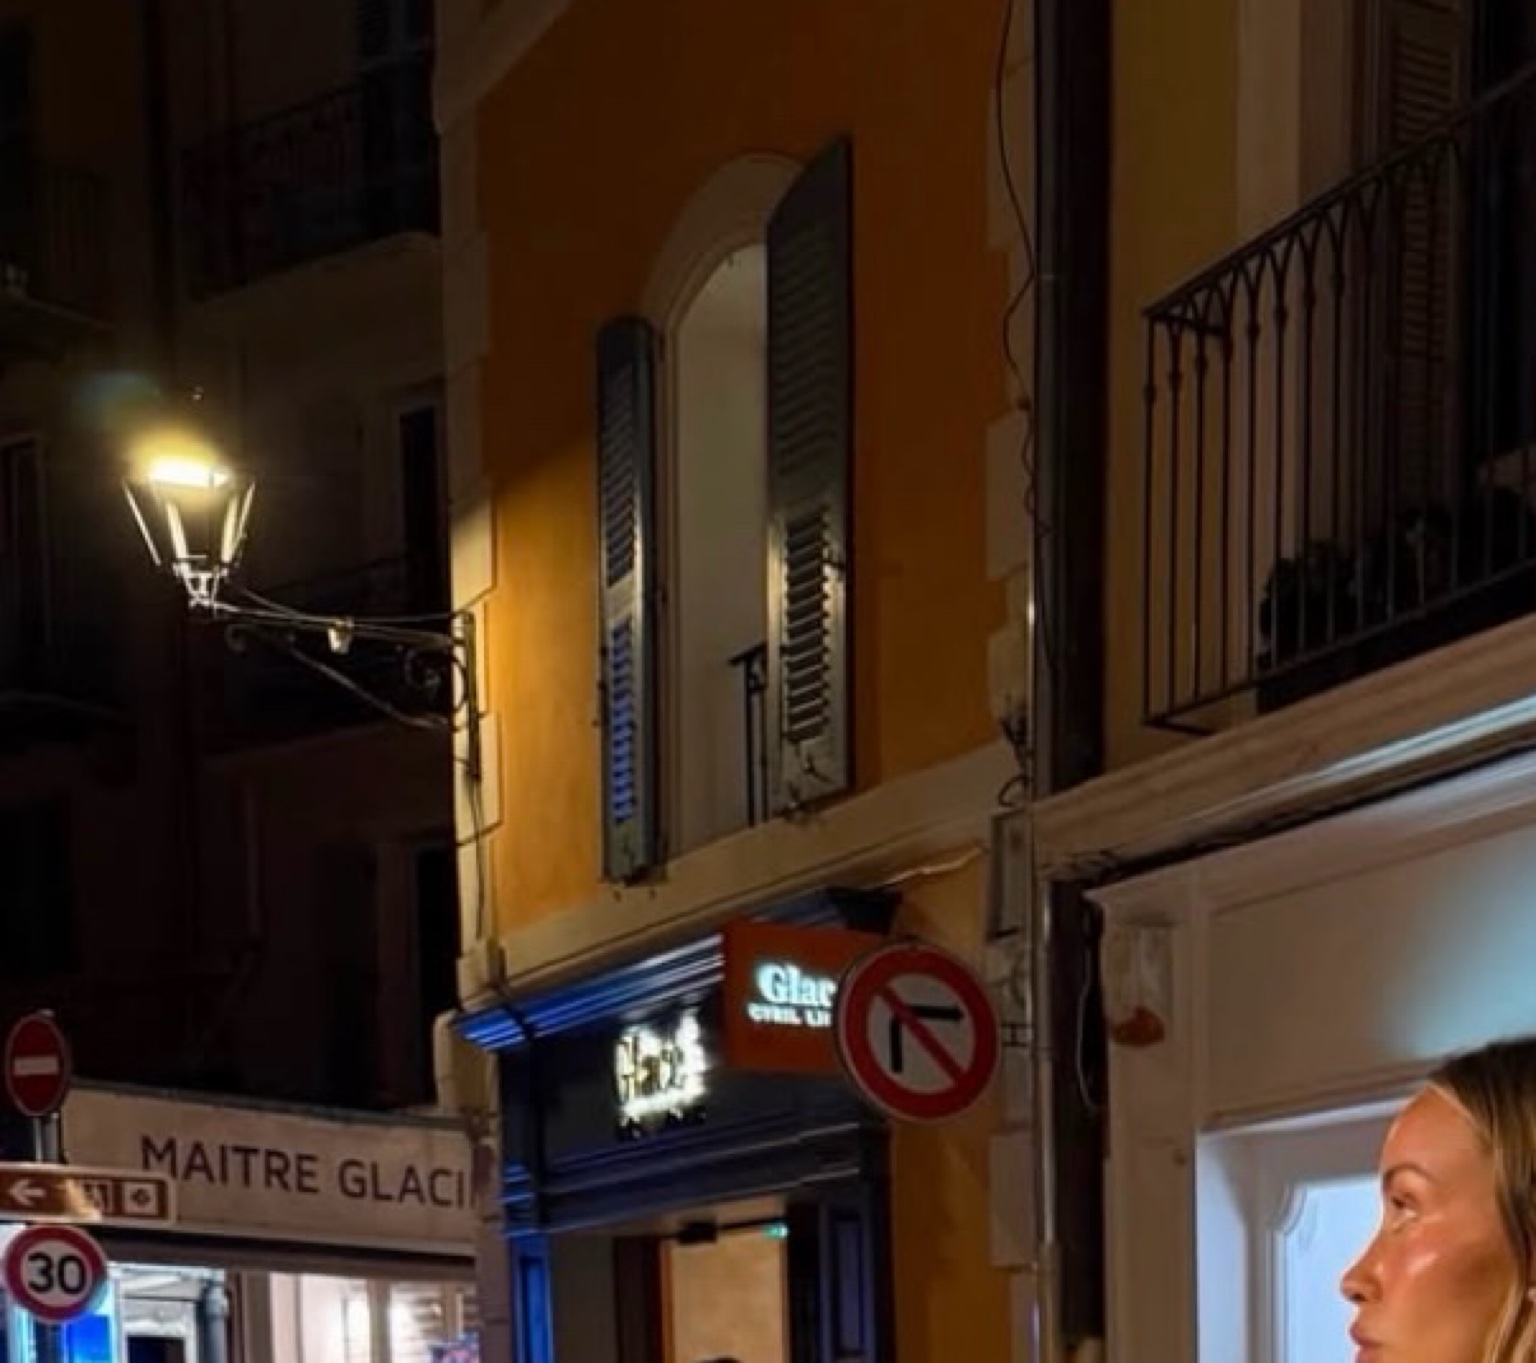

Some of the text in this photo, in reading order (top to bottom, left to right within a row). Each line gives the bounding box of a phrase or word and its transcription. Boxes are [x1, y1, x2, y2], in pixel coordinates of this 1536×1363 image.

[142, 1136, 477, 1209] MAITRE GLACI
[27, 1252, 87, 1293] 30
